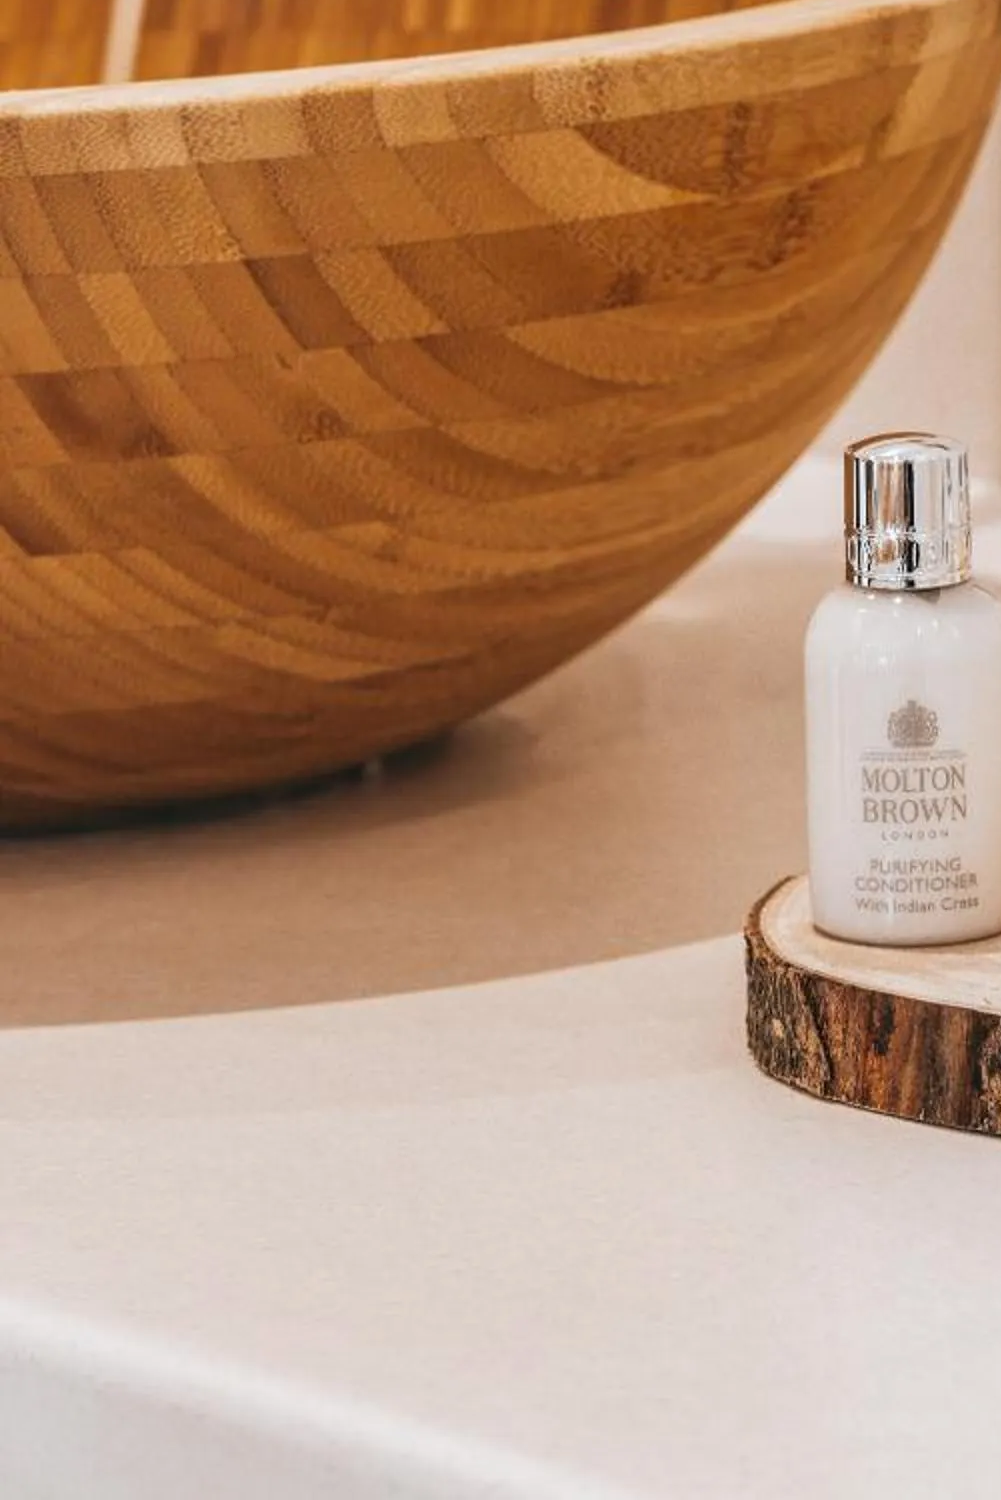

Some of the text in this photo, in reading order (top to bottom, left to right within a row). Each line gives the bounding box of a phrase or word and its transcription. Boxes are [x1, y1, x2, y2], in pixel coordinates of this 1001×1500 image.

[860, 763, 967, 794] MOLTON
[862, 794, 969, 825] BROWN
[881, 829, 950, 842] LONDON
[870, 856, 962, 874] PURIFYING
[854, 872, 979, 893] CONDITIONER
[855, 895, 980, 914] With Indian Cress
